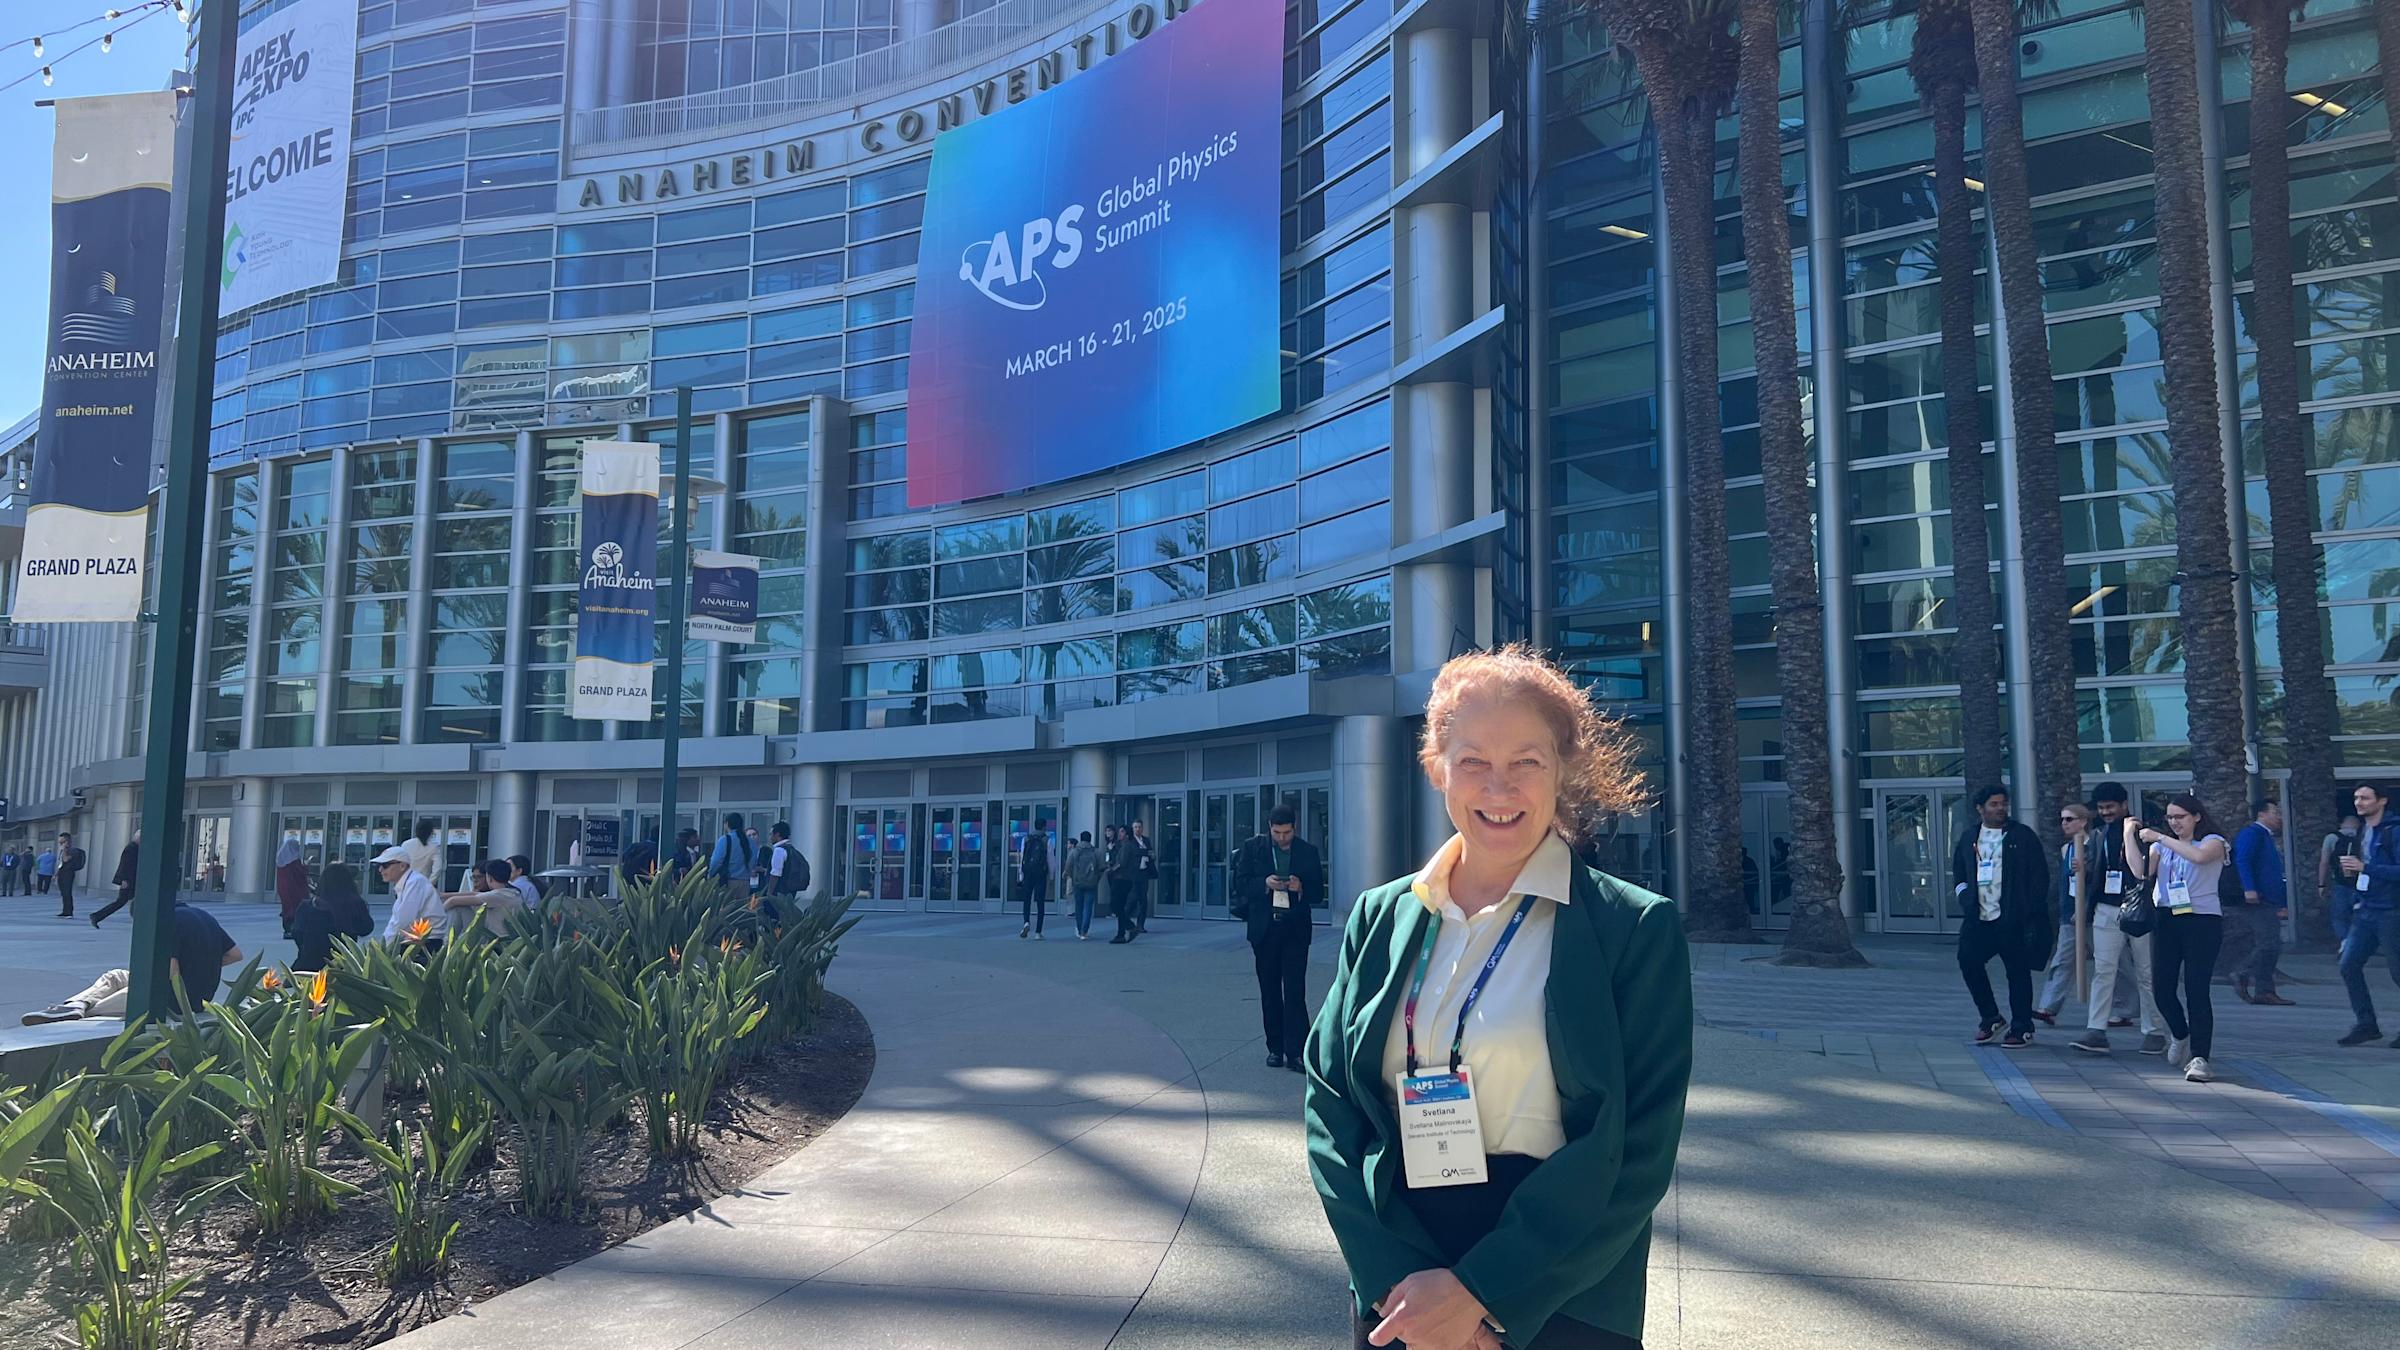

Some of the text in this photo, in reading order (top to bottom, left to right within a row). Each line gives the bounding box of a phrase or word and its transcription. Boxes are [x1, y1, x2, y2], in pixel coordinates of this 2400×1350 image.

[236, 27, 296, 87] APEX
[249, 51, 310, 106] EXPO
[236, 108, 255, 131] IPC
[225, 127, 333, 204] ELCOME
[579, 140, 814, 207] ANAHEIM
[980, 131, 1238, 290] APS Global Physics
[1095, 200, 1171, 253] Summit
[1005, 341, 1072, 379] MARCH
[1078, 332, 1097, 358] 16
[1112, 320, 1136, 347] 21,
[1142, 296, 1187, 335] 2025
[48, 351, 155, 374] ANAHEIM
[50, 370, 148, 381] CONVENTION CENTER
[56, 404, 134, 417] anaheim.net
[27, 558, 137, 576] GRAND PLAZA
[584, 563, 654, 590] Anaheim
[585, 605, 648, 616] visitanaheim.org
[700, 598, 750, 608] ANAHEIM
[580, 686, 648, 697] GRAND PLAZA
[1416, 1080, 1433, 1090] APS
[1422, 1108, 1456, 1116] Svetlana
